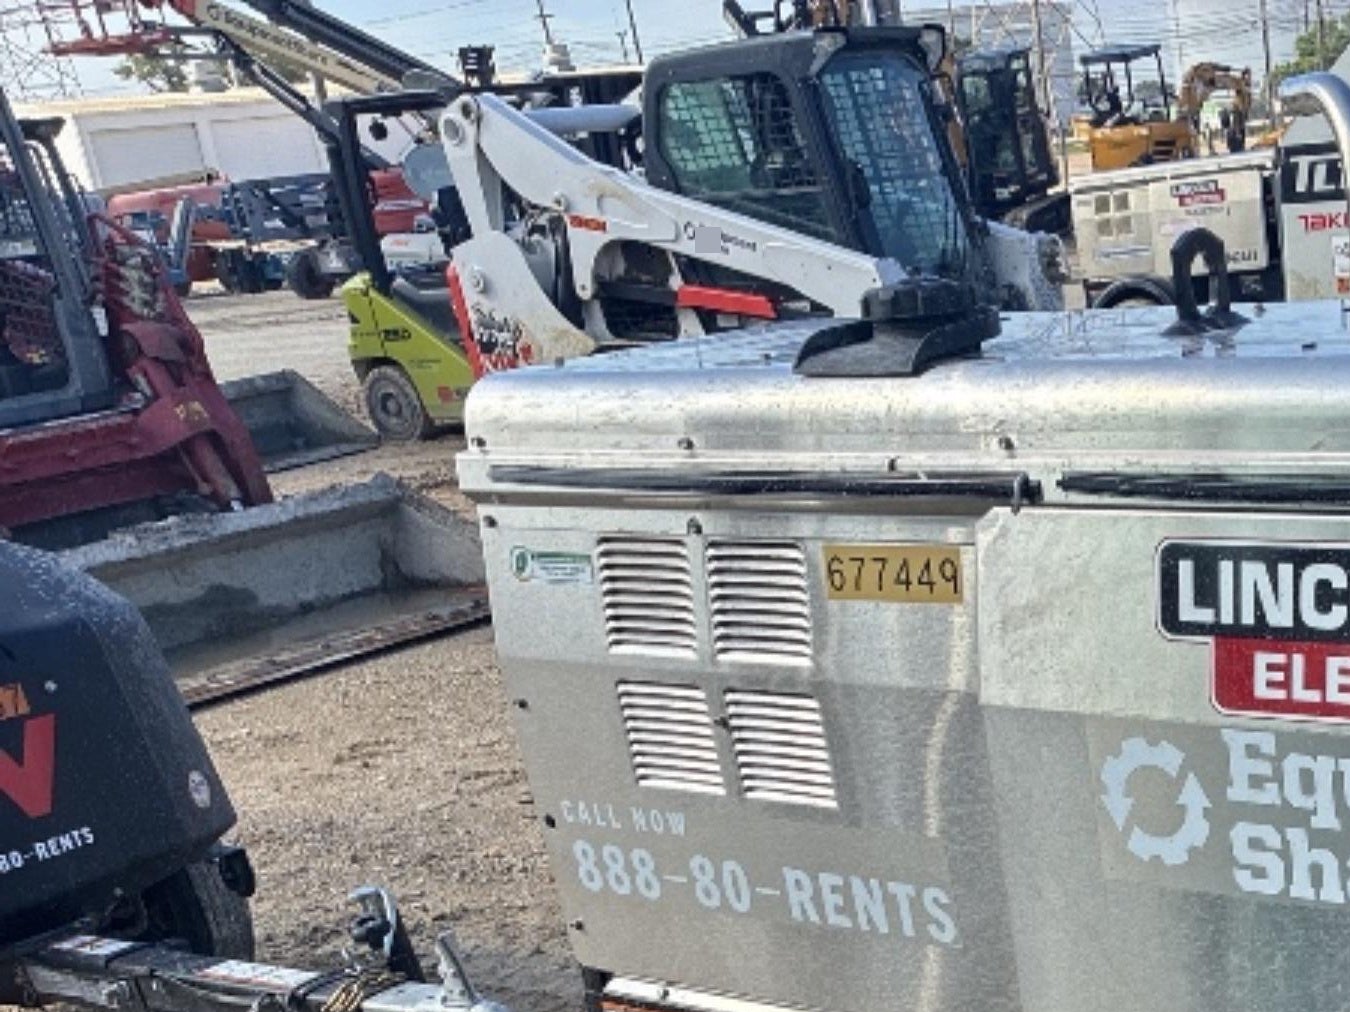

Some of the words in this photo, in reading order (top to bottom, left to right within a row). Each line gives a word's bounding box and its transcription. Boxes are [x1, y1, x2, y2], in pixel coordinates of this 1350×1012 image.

[826, 555, 961, 595] 677449
[560, 800, 623, 831] CALL
[632, 806, 687, 835] NOW
[573, 839, 958, 945] 888-80-RENTS
